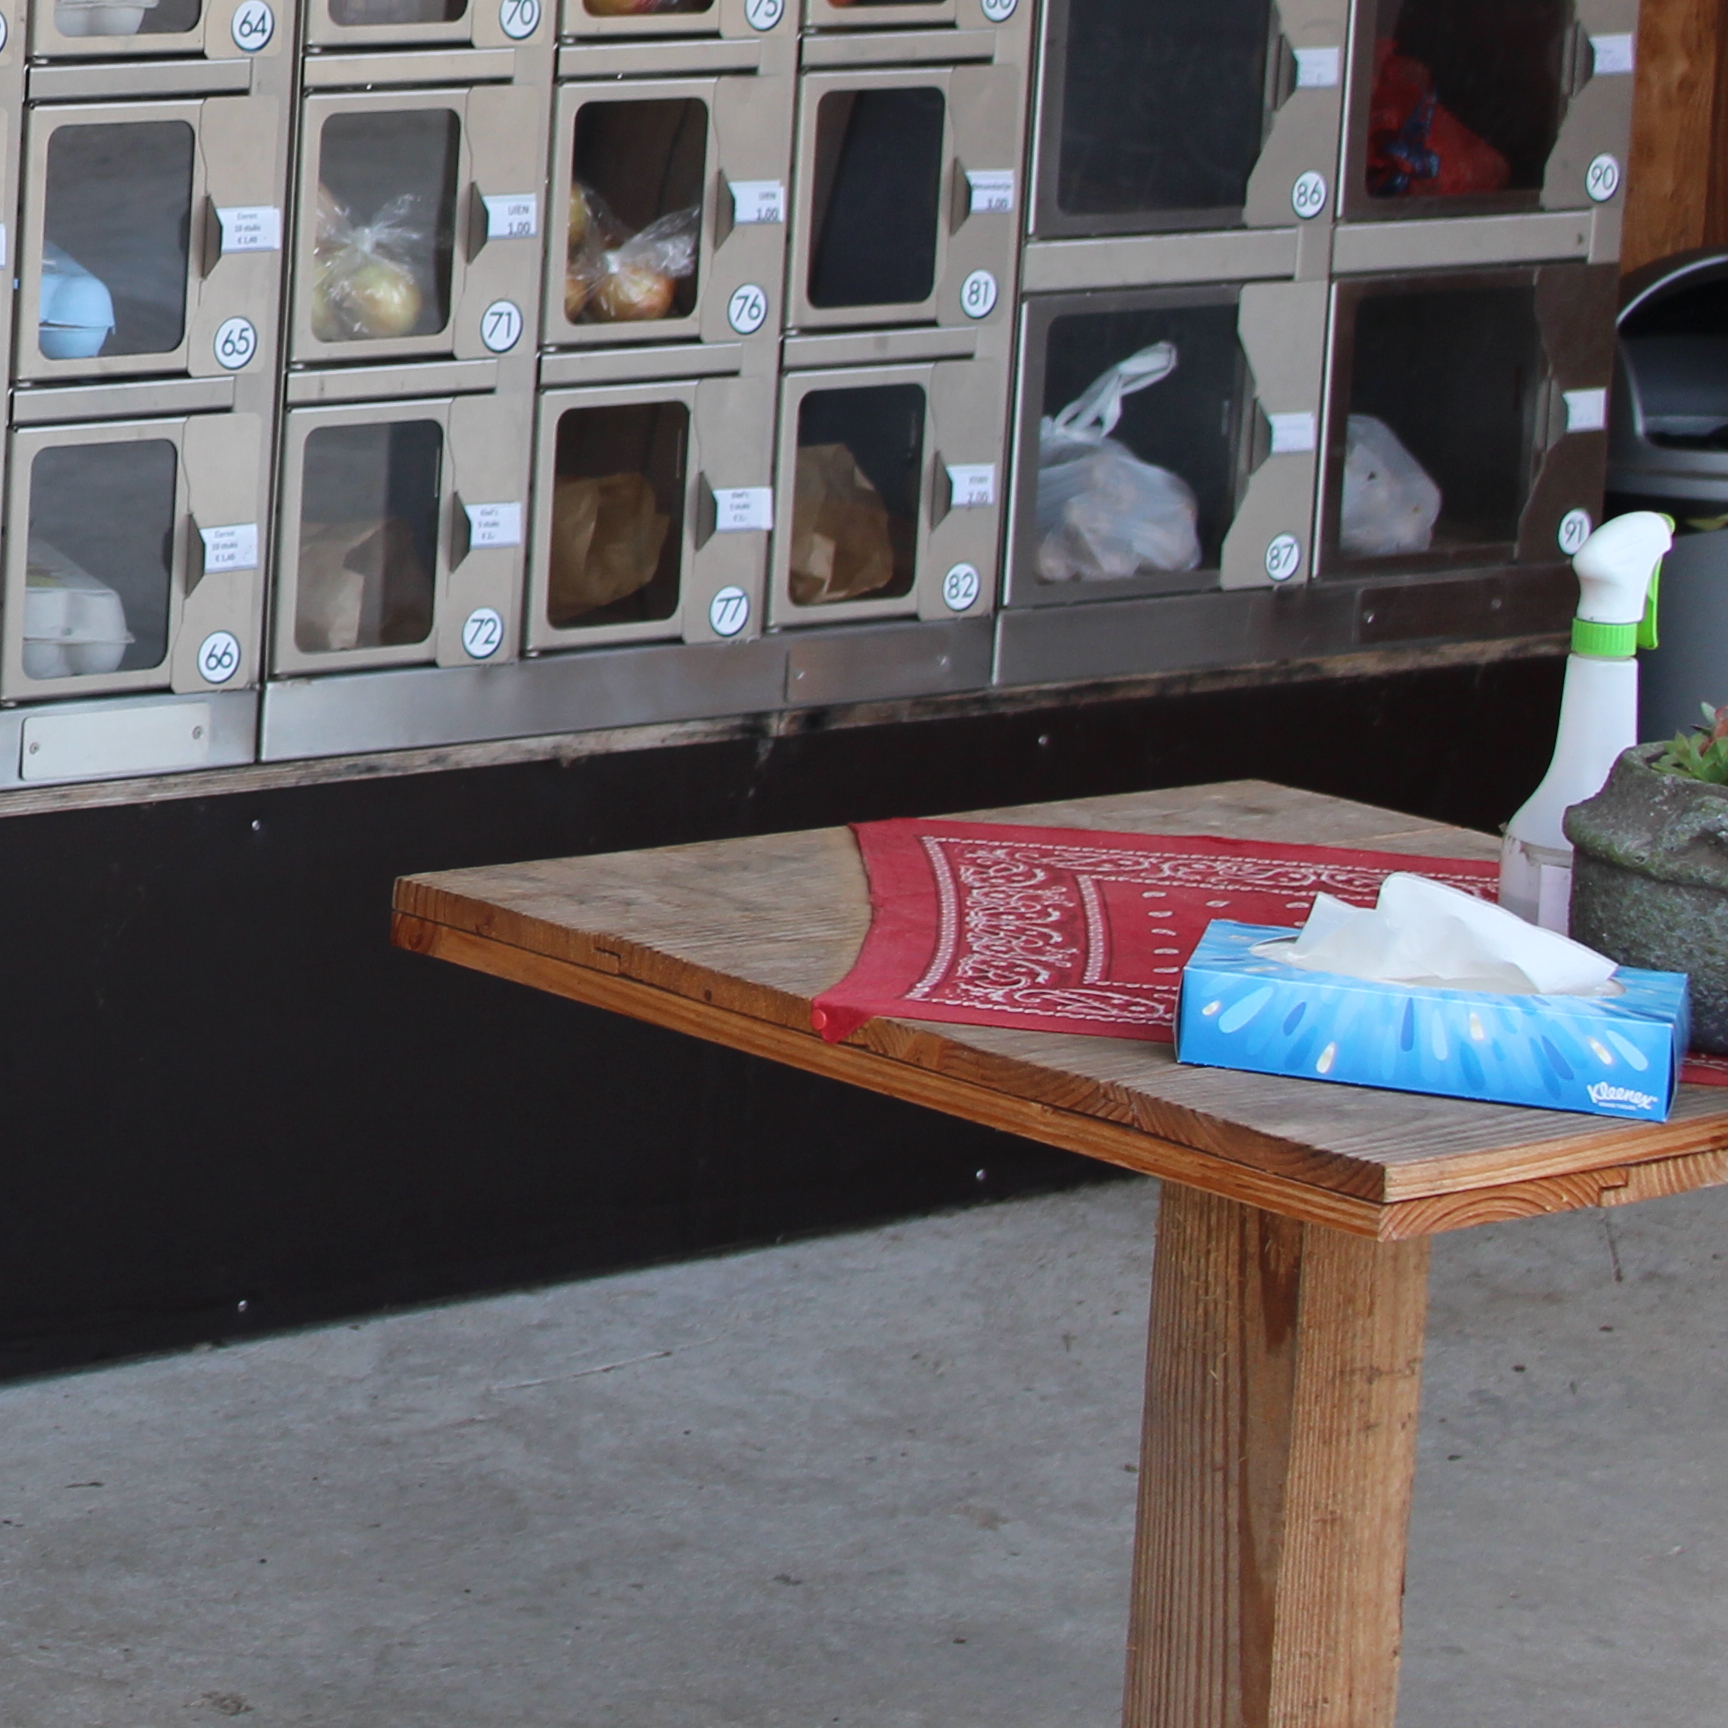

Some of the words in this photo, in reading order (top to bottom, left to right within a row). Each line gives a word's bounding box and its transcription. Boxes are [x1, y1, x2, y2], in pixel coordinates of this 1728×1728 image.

[1592, 164, 1615, 190] 90
[508, 205, 529, 215] UIEN
[508, 222, 530, 236] 1,00
[488, 312, 512, 338] 71
[1270, 543, 1294, 571] 87
[948, 572, 974, 599] 82
[717, 596, 742, 624] 77
[206, 643, 233, 671] 66
[1586, 1081, 1659, 1109] Kleenex
